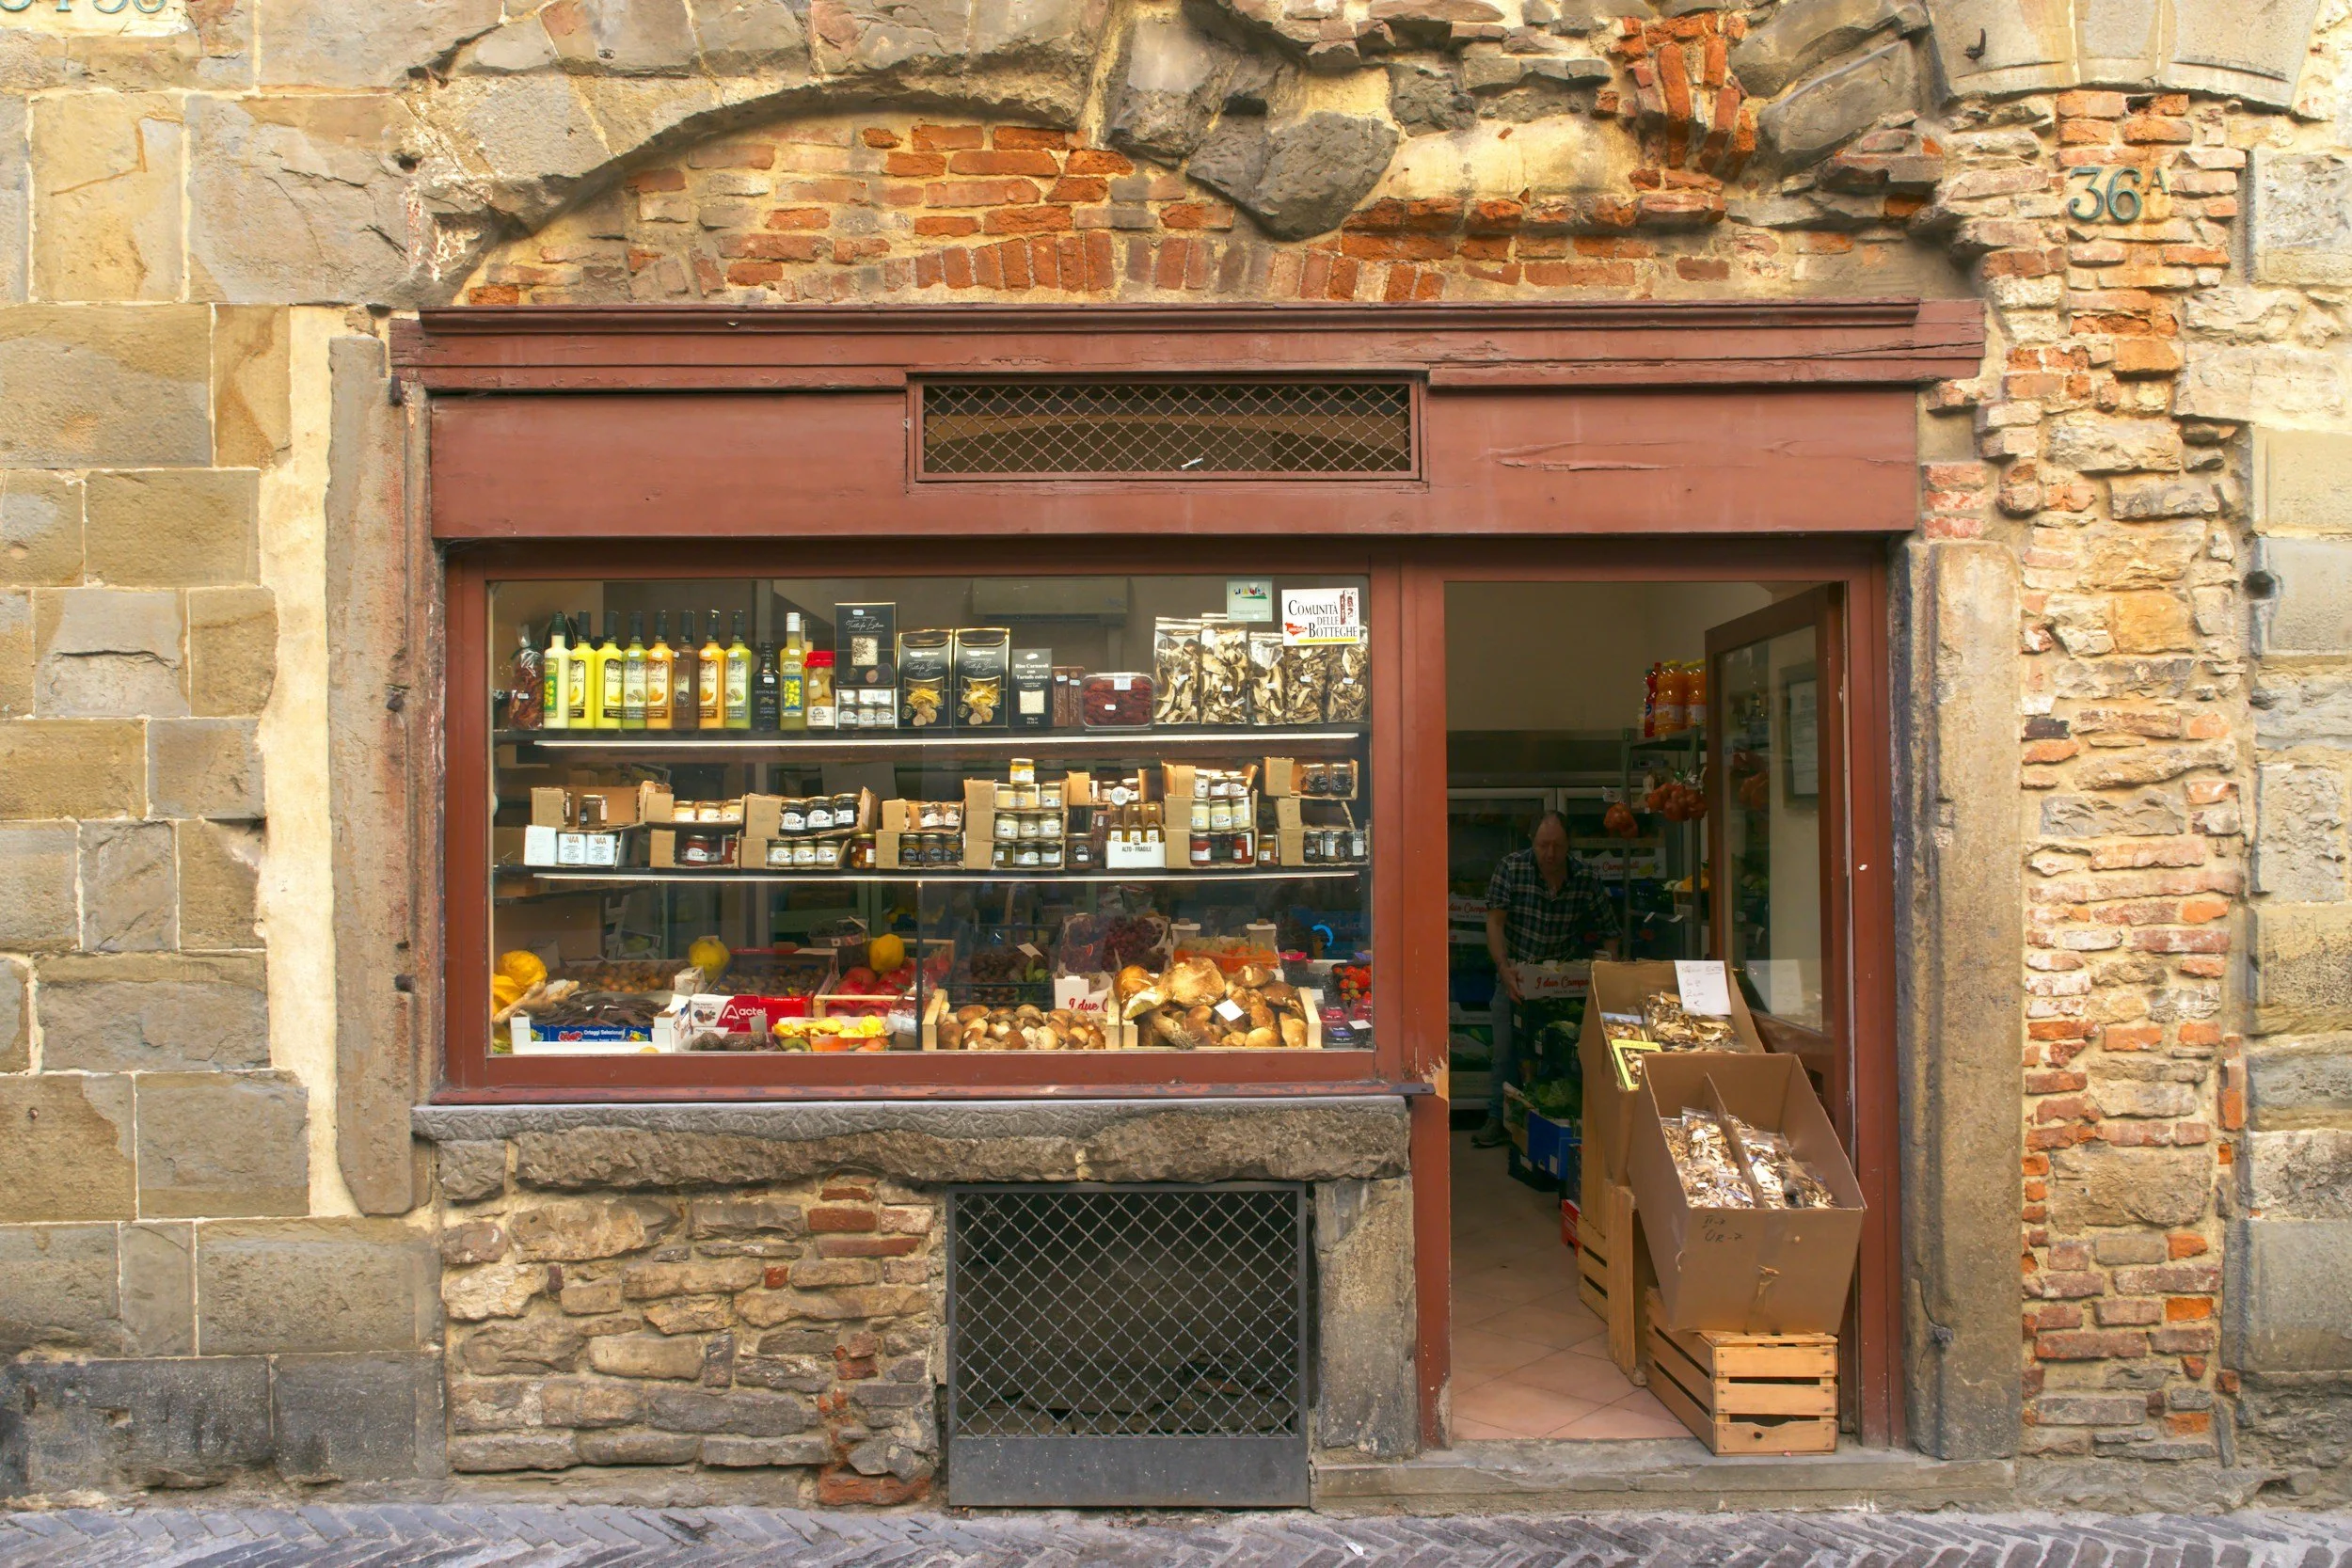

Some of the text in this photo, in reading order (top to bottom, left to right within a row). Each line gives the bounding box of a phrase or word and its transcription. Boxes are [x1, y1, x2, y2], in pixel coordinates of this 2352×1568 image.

[1288, 599, 1339, 616] COMUNITÀ
[1317, 616, 1340, 626] DELLE
[1309, 622, 1358, 638] BOTTEGHE
[1077, 998, 1100, 1011] due
